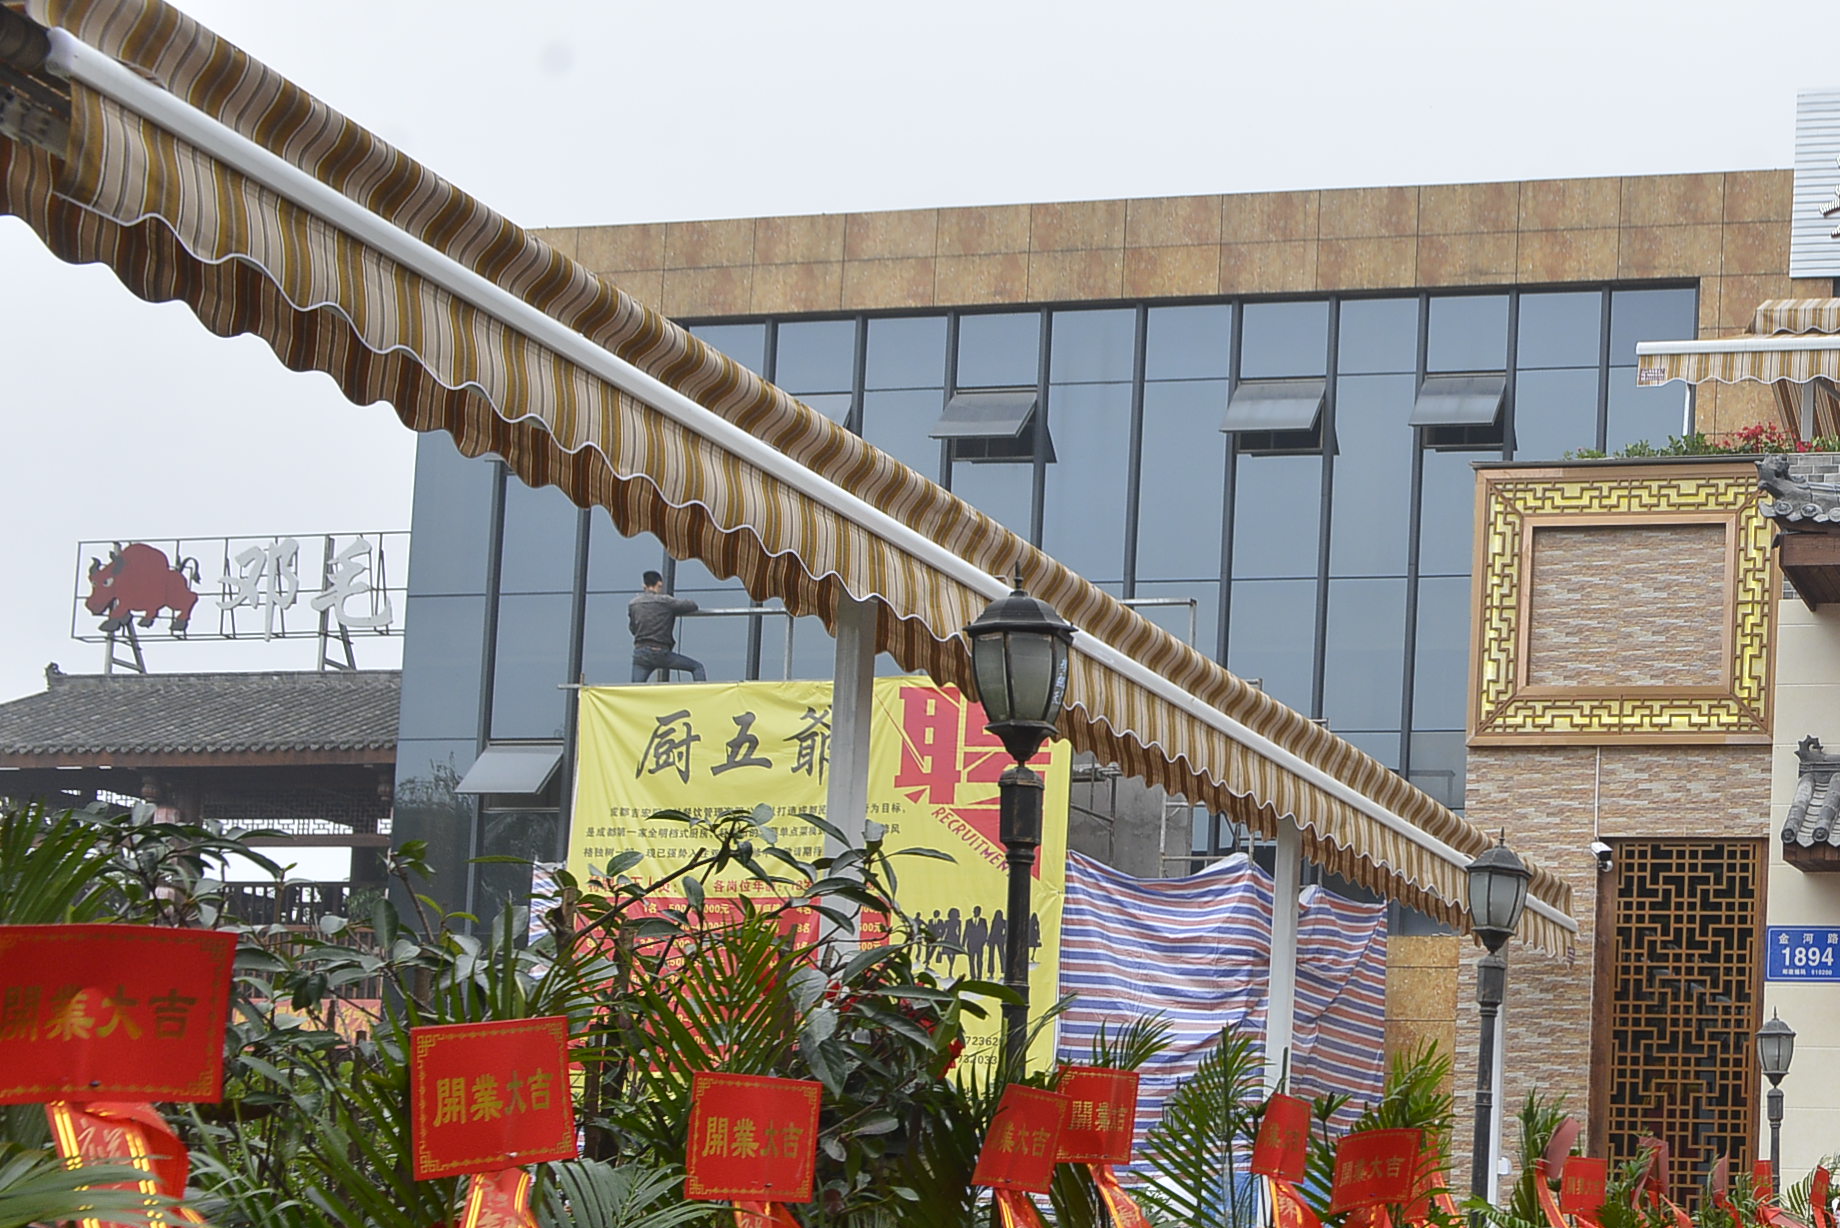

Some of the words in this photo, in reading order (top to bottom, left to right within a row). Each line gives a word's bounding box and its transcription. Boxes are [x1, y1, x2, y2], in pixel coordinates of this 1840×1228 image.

[931, 806, 1010, 878] RECRUITMEN
[1778, 933, 1839, 945] 金河路
[1781, 946, 1834, 967] 1894
[0, 984, 197, 1042] 開業大吉
[433, 1067, 553, 1127] 開業大吉
[702, 1116, 804, 1159] 開業大吉
[1339, 1155, 1406, 1188] 開業大吉
